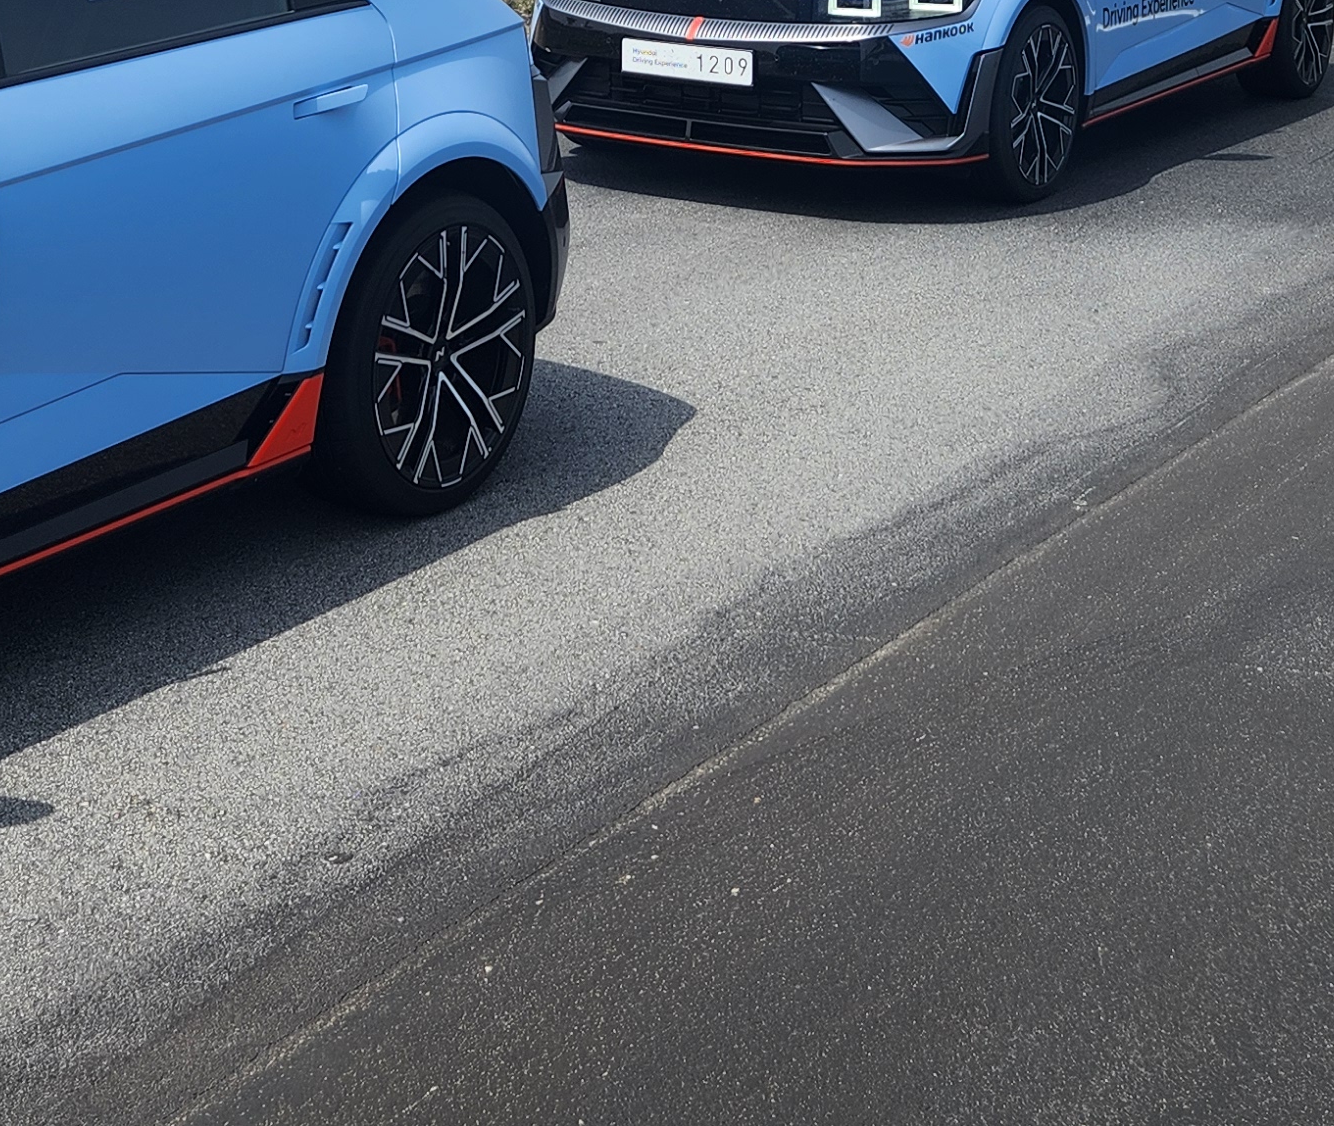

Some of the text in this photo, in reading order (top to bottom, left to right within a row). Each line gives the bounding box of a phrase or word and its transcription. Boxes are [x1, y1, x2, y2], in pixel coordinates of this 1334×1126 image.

[1102, 0, 1139, 29] Driving
[632, 48, 657, 56] Hyundai
[696, 54, 748, 76] 1209
